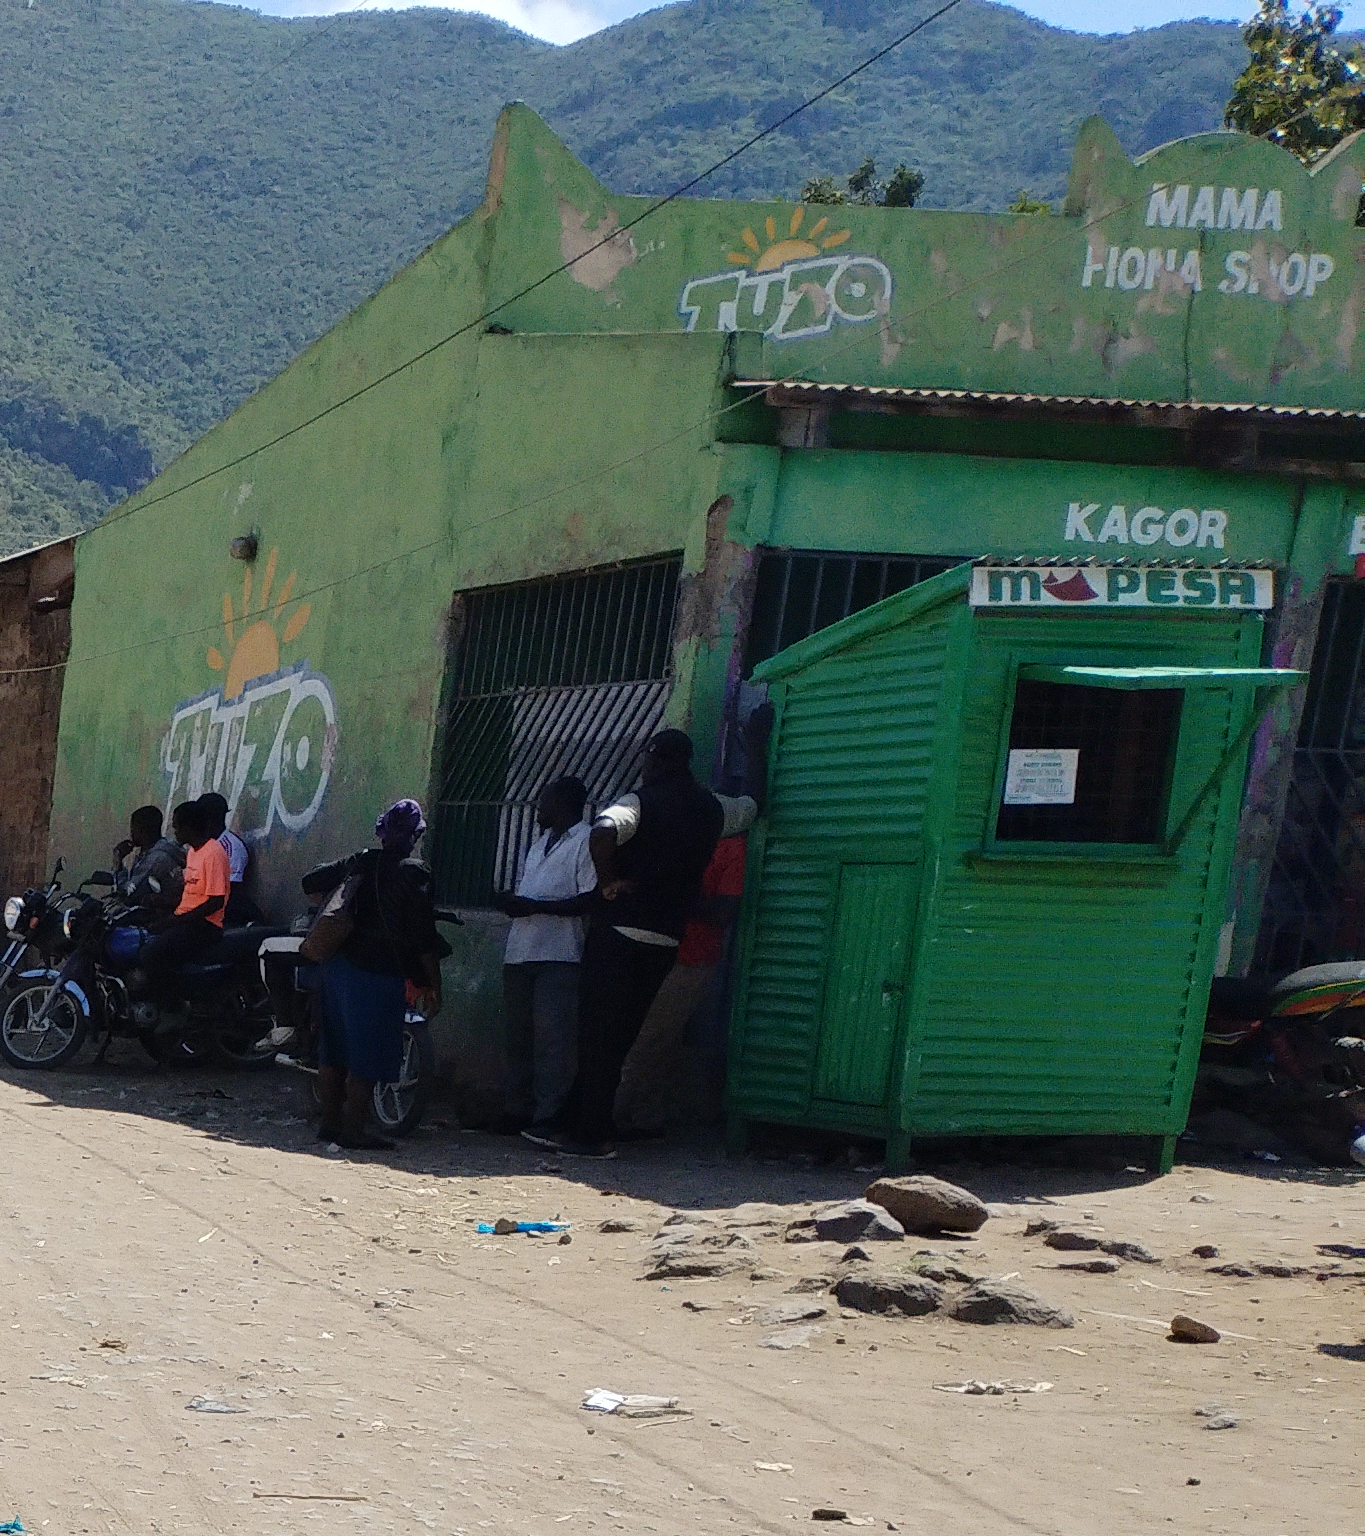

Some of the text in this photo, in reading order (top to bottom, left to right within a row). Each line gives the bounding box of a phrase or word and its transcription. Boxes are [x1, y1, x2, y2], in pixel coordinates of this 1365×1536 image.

[1145, 182, 1284, 231] MAMA
[1064, 502, 1227, 549] KAGOR
[1107, 567, 1256, 605] PESA
